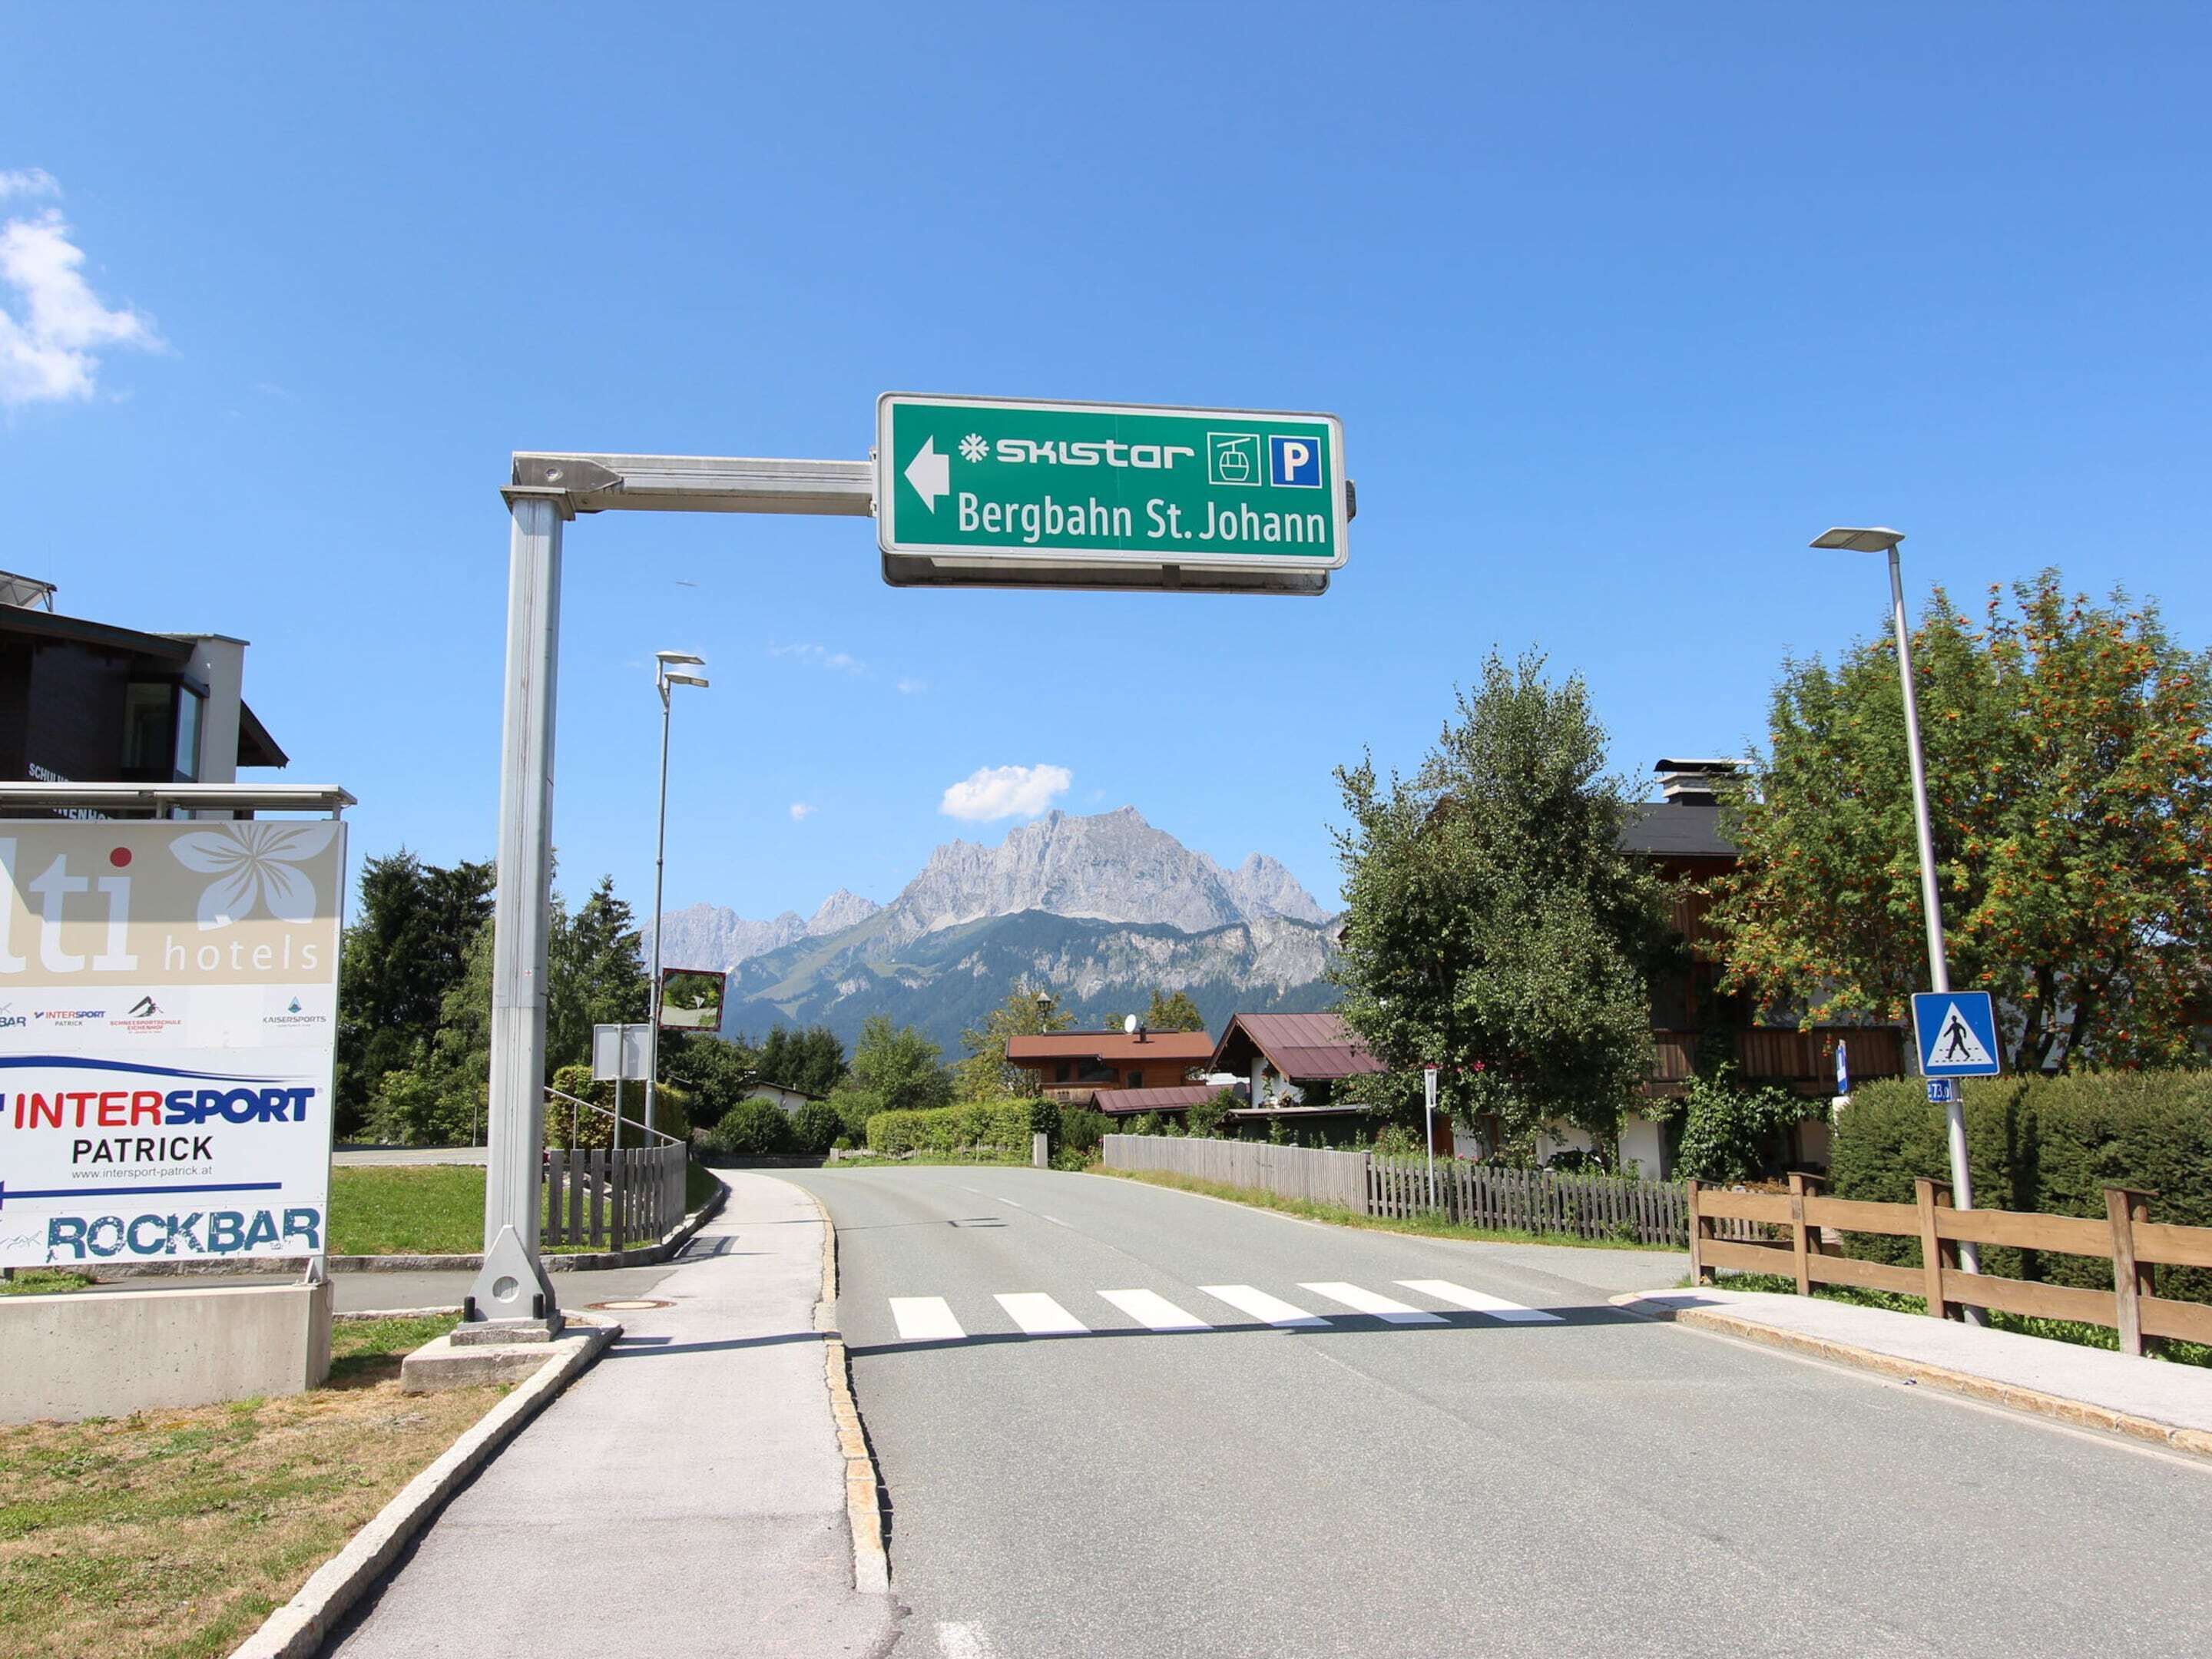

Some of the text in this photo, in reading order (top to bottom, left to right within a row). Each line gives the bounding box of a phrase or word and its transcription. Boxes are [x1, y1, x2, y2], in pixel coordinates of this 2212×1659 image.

[1283, 442, 1309, 482] P
[959, 492, 1326, 544] Bergbahn St. Johann
[164, 934, 318, 971] hotels
[45, 1010, 106, 1019] INTERSPORT
[263, 1015, 326, 1024] KAISERSPORTS
[14, 1087, 316, 1130] INTERSPORT
[71, 1136, 214, 1164] PATRICK
[71, 1165, 213, 1180] www.intersport-patrick.at
[46, 1207, 321, 1263] ROCKBAR
